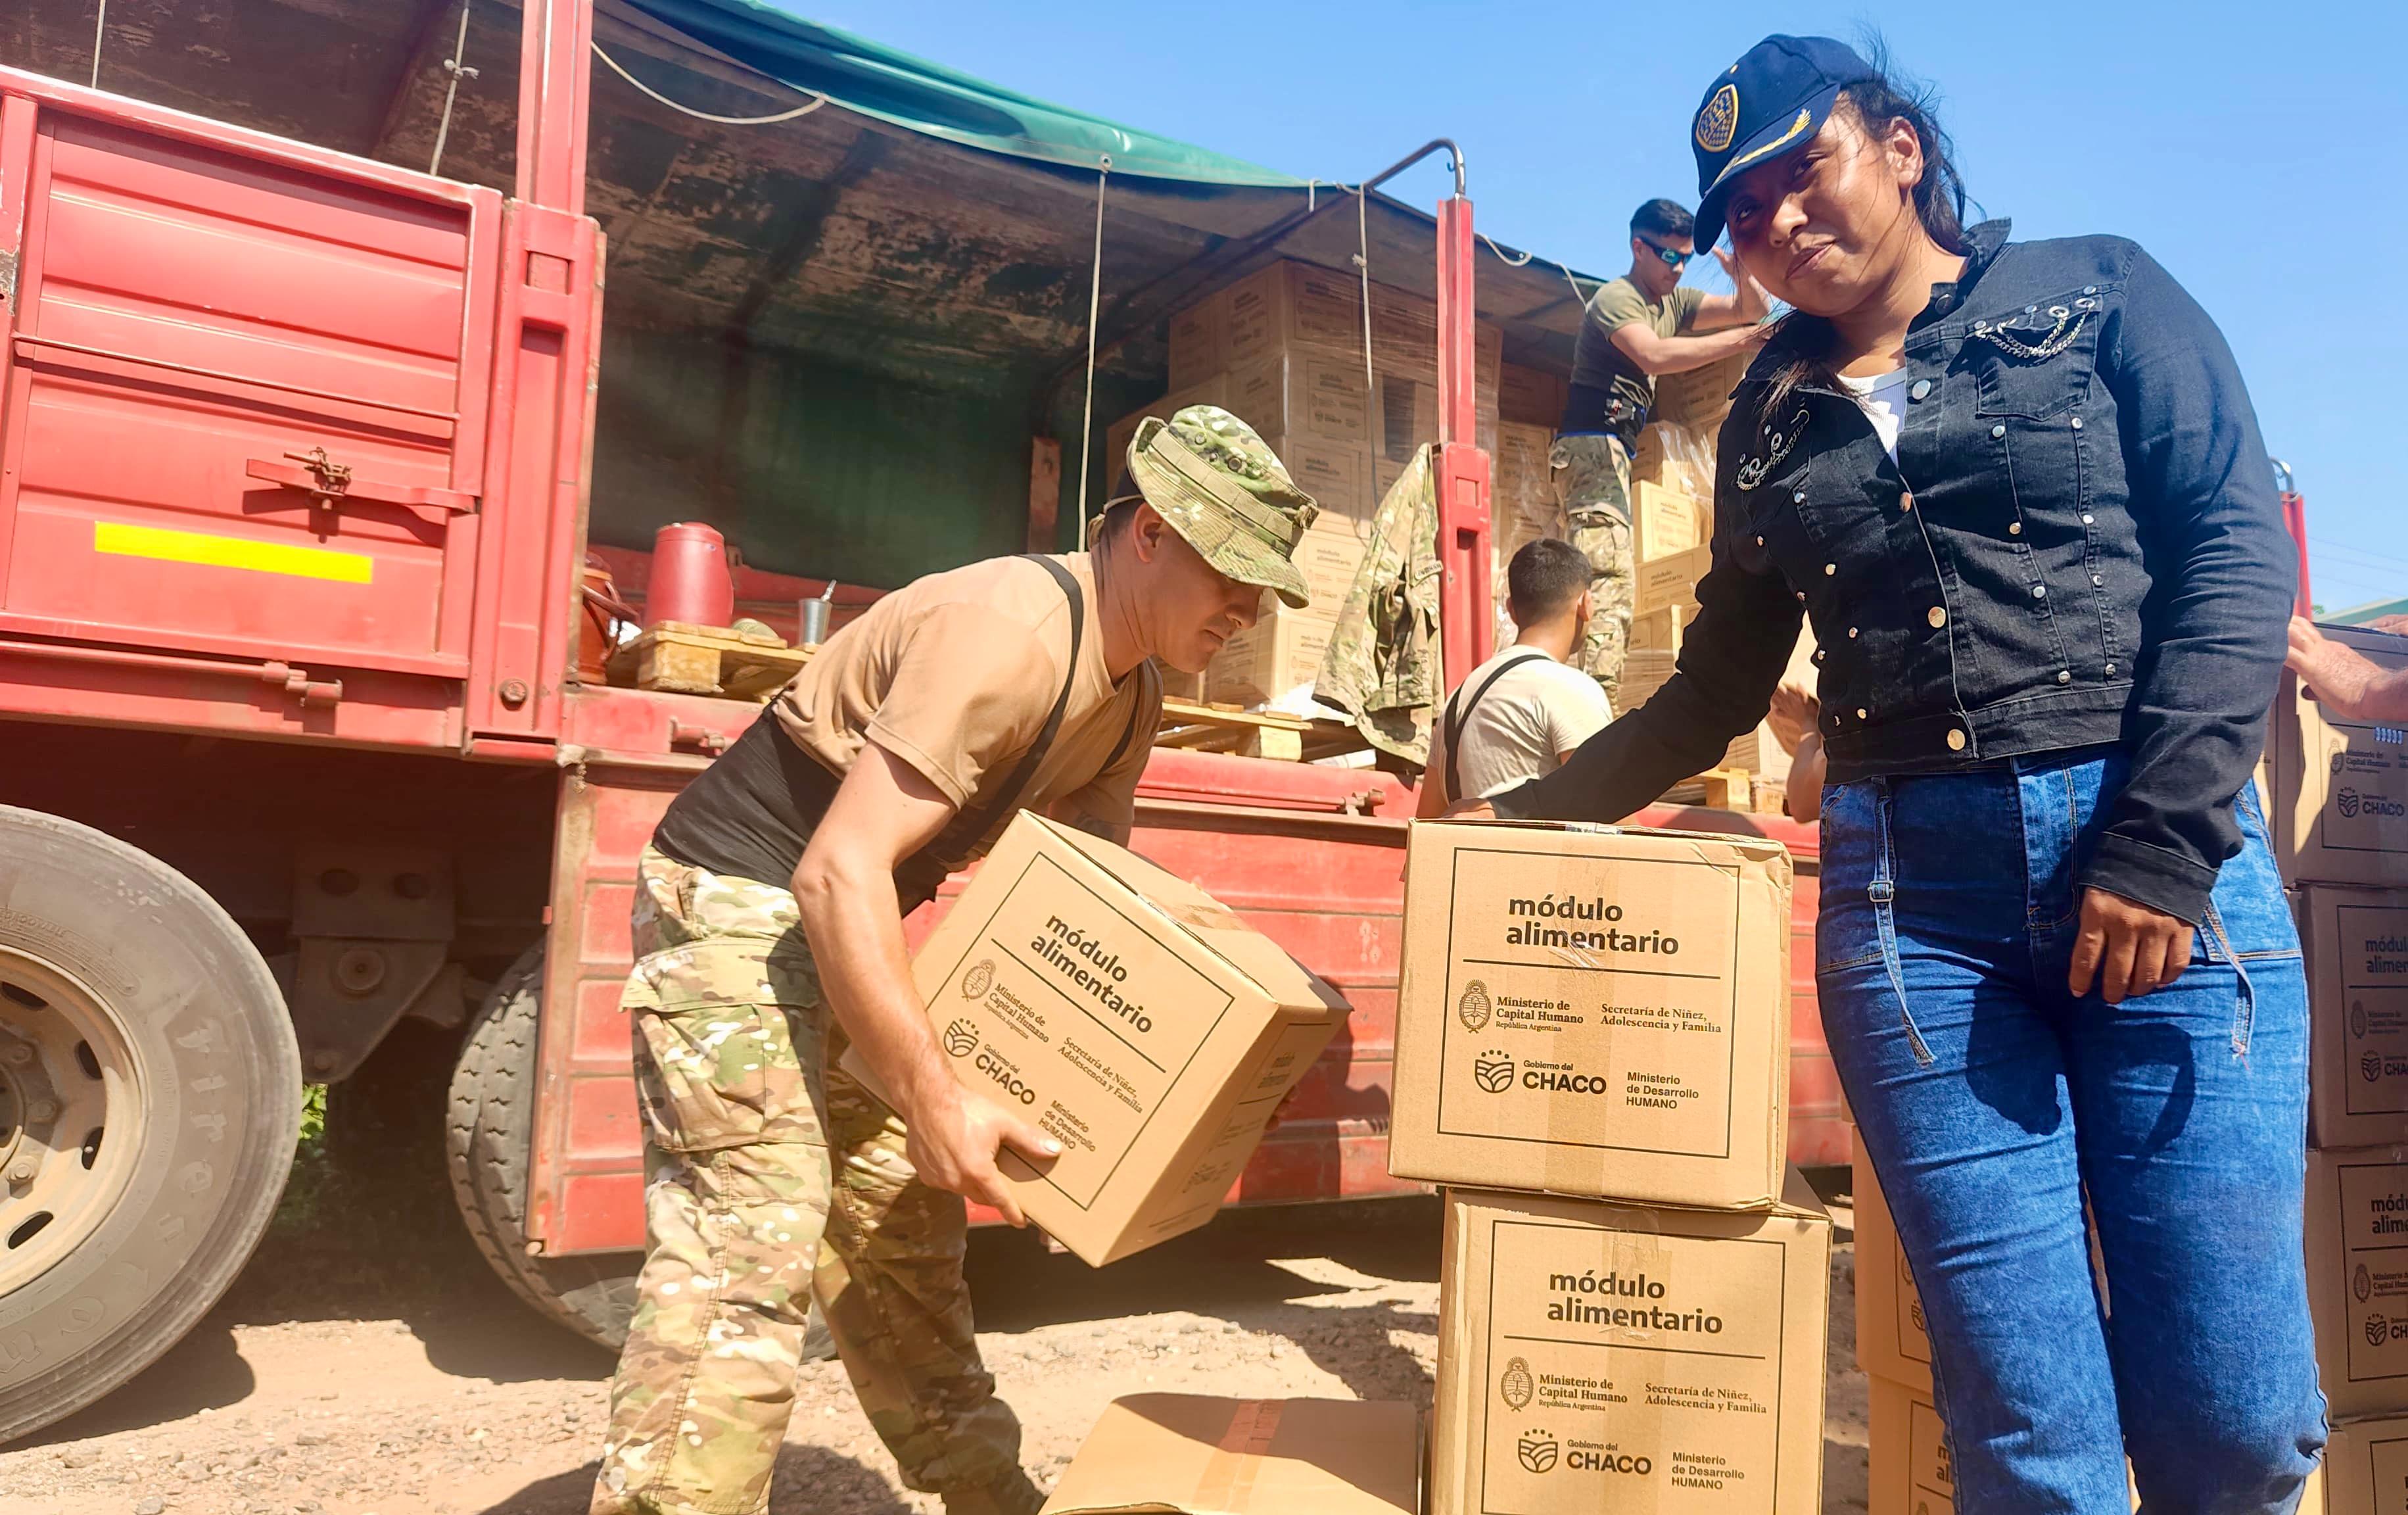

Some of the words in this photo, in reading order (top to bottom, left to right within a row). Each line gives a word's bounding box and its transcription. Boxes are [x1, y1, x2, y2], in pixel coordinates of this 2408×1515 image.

[1509, 894, 1623, 922] módulo
[1045, 915, 1127, 982] módulo
[1506, 921, 1679, 955] alimentario
[1031, 935, 1152, 1033] alimentario
[995, 982, 1035, 1019] Ministerio
[1035, 1015, 1046, 1026] de
[1496, 996, 1555, 1011] Ministerio
[1557, 1001, 1571, 1011] de
[1601, 1003, 1655, 1017] Secretaría
[1657, 1006, 1670, 1017] de
[1672, 1008, 1707, 1022] Niñez,
[989, 992, 1018, 1017] Capital
[1016, 1013, 1049, 1043] Humano
[1496, 1008, 1536, 1022] Capital
[1538, 1011, 1584, 1024] Humano
[1600, 1016, 1670, 1030] Adolescencia
[1672, 1022, 1680, 1033] y
[1682, 1019, 1722, 1033] Familia
[1064, 1036, 1102, 1070] Secretaría
[1102, 1066, 1114, 1078] de
[1112, 1072, 1137, 1098] Niñez,
[1627, 1072, 1681, 1085] Ministerio
[976, 1054, 1035, 1105] CHACO
[1057, 1046, 1108, 1087] Adolescencia
[1113, 1088, 1143, 1114] Familia
[1522, 1071, 1607, 1094] CHACO
[1626, 1084, 1640, 1094] de
[1643, 1086, 1699, 1099] Desarrollo
[1626, 1096, 1678, 1109] HUMANO
[1051, 1099, 1089, 1133] Ministerio
[1038, 1117, 1076, 1150] HUMANO
[1045, 1109, 1056, 1121] de
[1056, 1117, 1097, 1152] Desarrollo
[1550, 1270, 1665, 1299] módulo
[1547, 1297, 1723, 1334] alimentario
[1539, 1374, 1597, 1389] Ministerio
[1599, 1378, 1614, 1389] de
[1645, 1382, 1699, 1397] Secretaría
[1701, 1387, 1715, 1397] de
[1717, 1389, 1753, 1403] Niñez,
[1539, 1386, 1578, 1401] Capital
[1580, 1389, 1628, 1404] Humano
[1645, 1395, 1716, 1411] Adolescencia
[1717, 1403, 1724, 1414] y
[1727, 1401, 1767, 1414] Familia
[1572, 1402, 1606, 1412] Argentina
[1567, 1451, 1652, 1476] CHACO
[1672, 1452, 1726, 1466] Ministerio
[1672, 1464, 1686, 1475] de
[1688, 1466, 1745, 1480] Desarrollo
[1672, 1477, 1723, 1491] HUMANO
